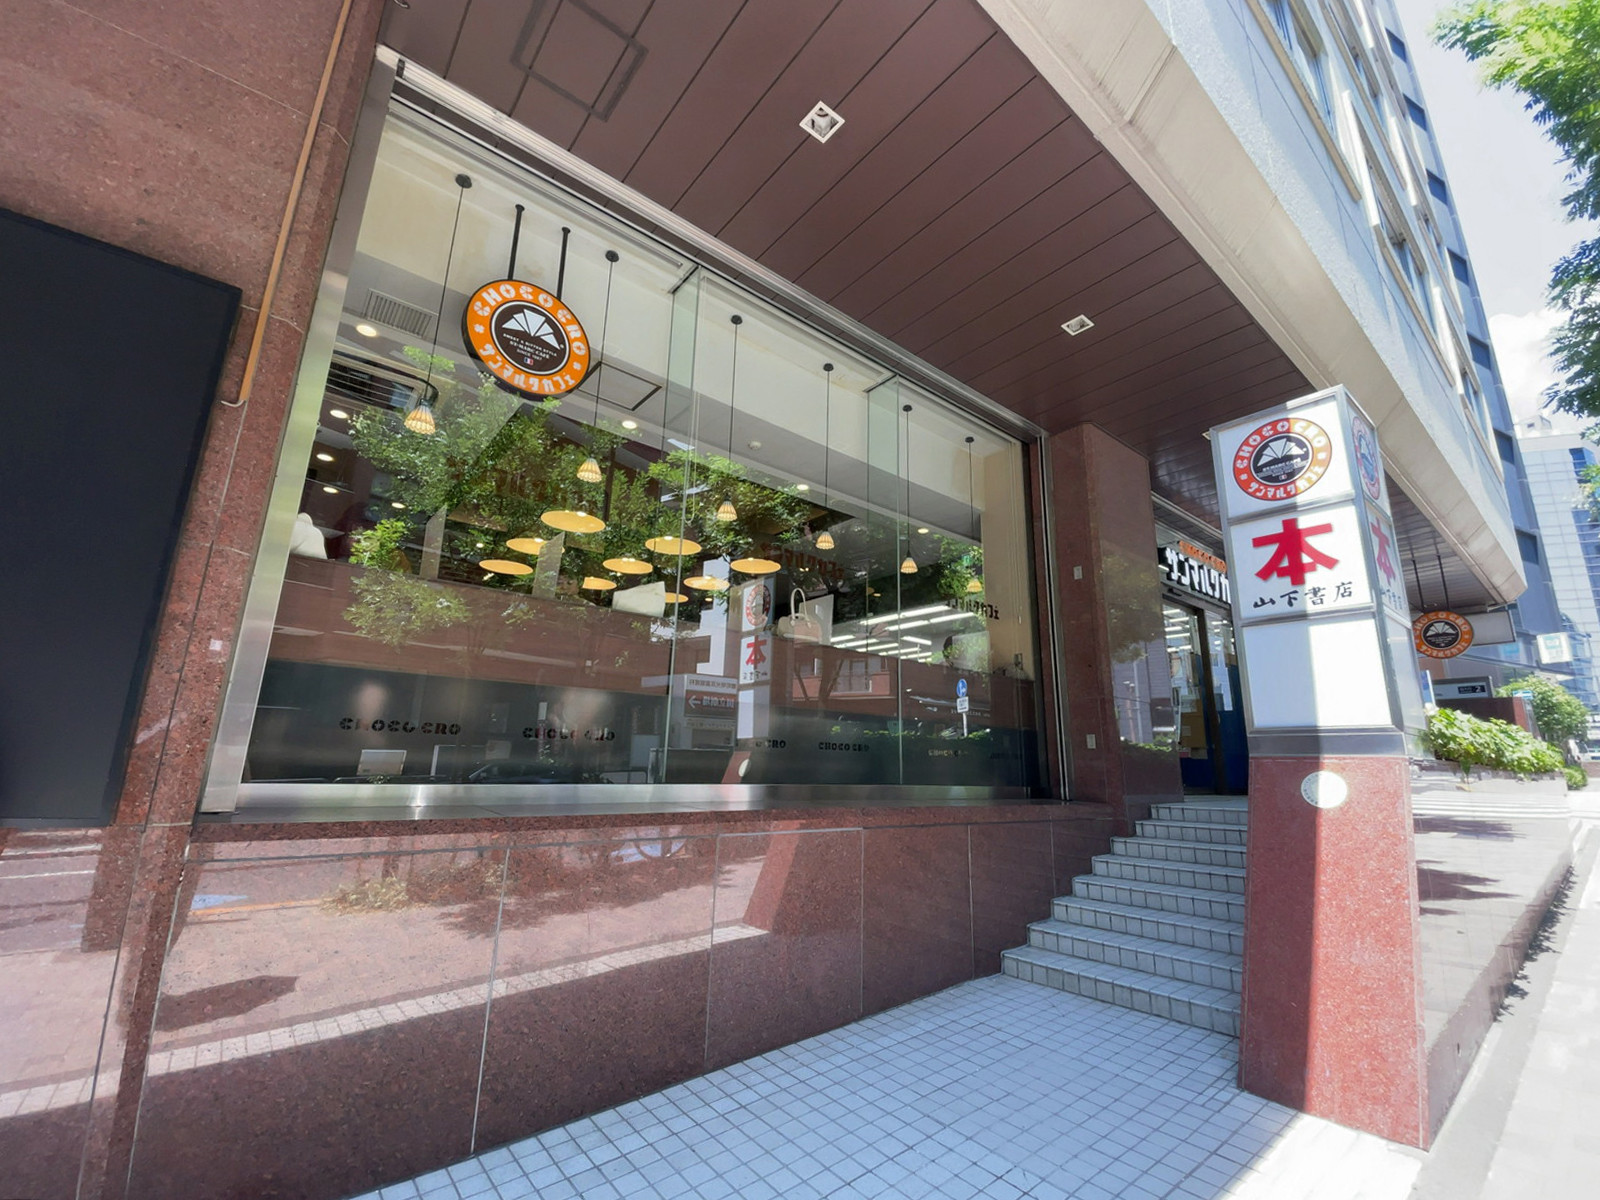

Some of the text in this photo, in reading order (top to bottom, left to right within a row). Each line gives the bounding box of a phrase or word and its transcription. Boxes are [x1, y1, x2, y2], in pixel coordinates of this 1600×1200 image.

[473, 283, 587, 356] CHOCO CRO
[480, 343, 576, 393] サンマルクカフェ
[1235, 420, 1328, 469] CHOCO CRO
[1252, 518, 1339, 587] 本
[1253, 581, 1354, 609] 山下書店
[421, 722, 461, 735] CRO
[818, 742, 850, 751] CHOCO
